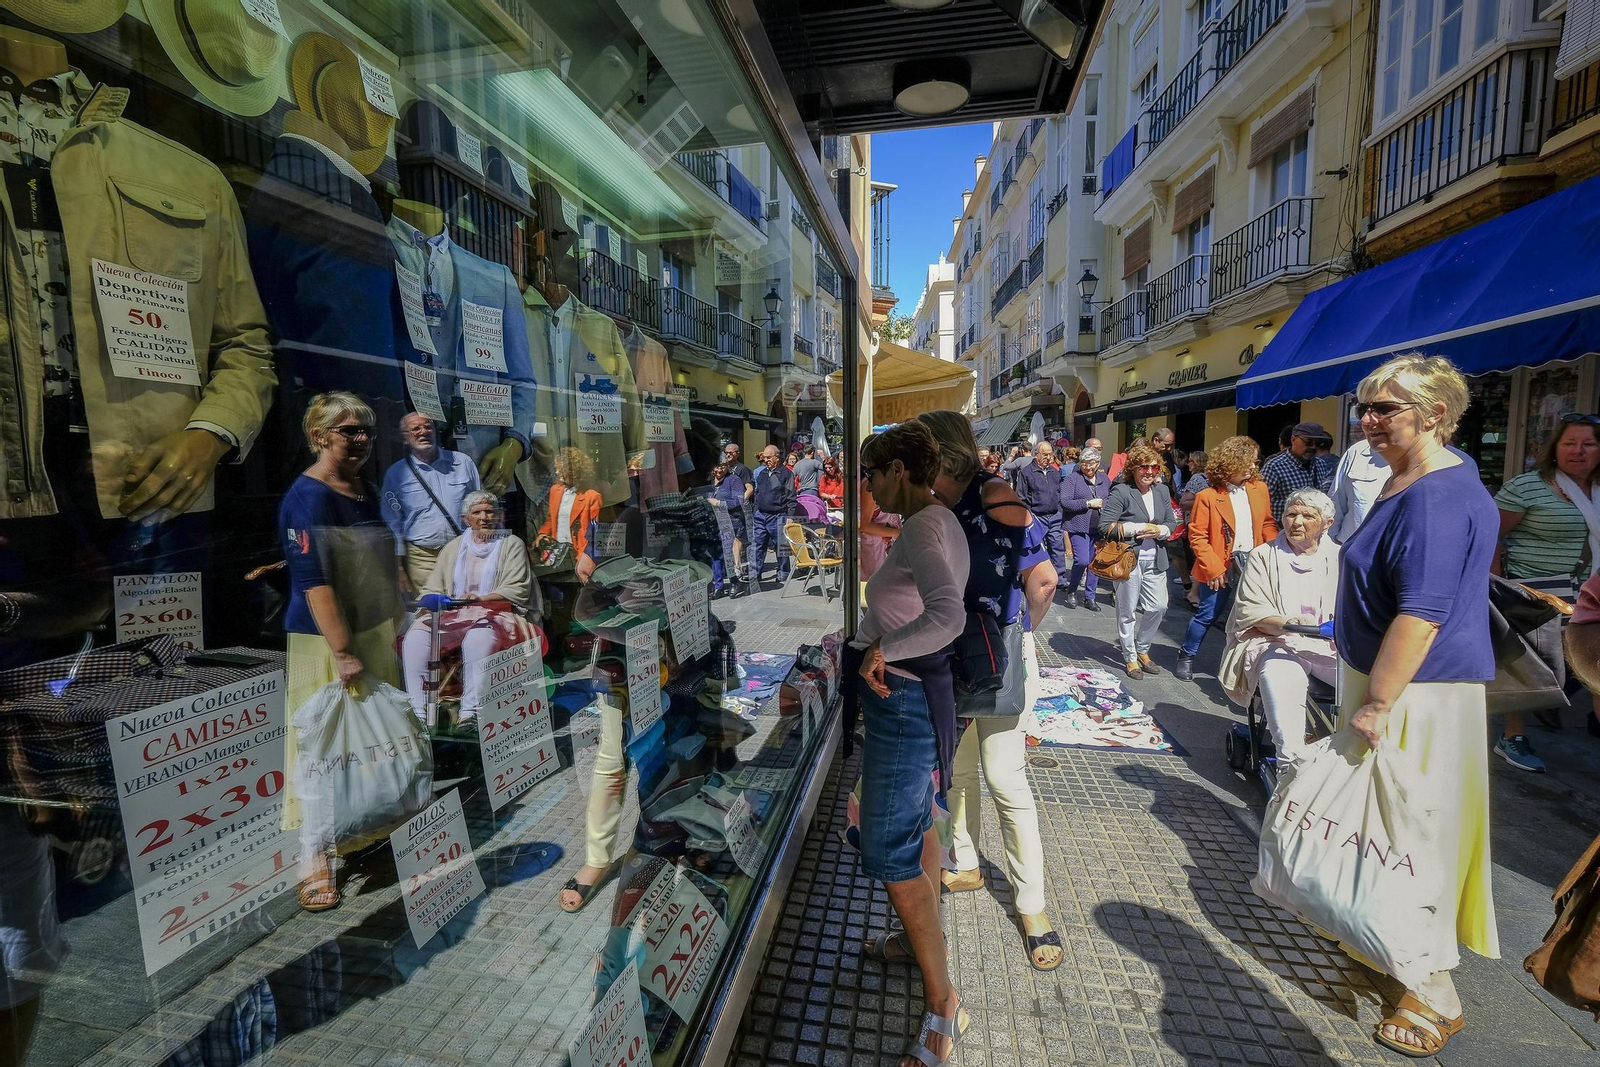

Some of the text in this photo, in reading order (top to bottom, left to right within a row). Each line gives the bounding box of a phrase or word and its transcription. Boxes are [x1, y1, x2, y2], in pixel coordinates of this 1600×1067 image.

[97, 262, 184, 291] Nueva Colección
[98, 277, 185, 304] Deportivas
[100, 290, 185, 313] Moda Primavera
[111, 326, 188, 346] Fresca-Ligera
[464, 320, 502, 335] Americanas
[110, 347, 195, 365] Tejido Natural
[117, 338, 186, 354] CALIDAD
[135, 367, 182, 380] Tinoco
[464, 383, 508, 395] DE REGALO
[117, 572, 199, 586] PANTALÓN
[120, 586, 197, 598] Algodón-Elastán
[158, 625, 196, 633] Fresco
[633, 634, 651, 649] POLOS
[478, 655, 500, 672] Nueva
[490, 659, 528, 686] POLOS
[478, 671, 542, 705] VERANO-Manga Corta
[120, 678, 277, 738] Nueva Colección
[640, 713, 658, 730] Tinoco
[143, 703, 267, 762] CAMISAS
[484, 715, 549, 754] Algodón Cotton
[487, 723, 548, 762] MUY FRESCO
[123, 725, 289, 794] VERANO-Manga Corta
[494, 746, 518, 764] Short
[504, 767, 548, 799] Tinoco
[396, 809, 462, 859] Manga Corta-Short sleeve
[408, 800, 446, 837] POLOS
[147, 838, 206, 874] Fácil
[164, 844, 224, 880] Short
[408, 880, 444, 911] Algodón
[417, 870, 472, 922] MUY FRESCO
[423, 881, 472, 927] SURTIDAZO
[180, 881, 287, 946] Tinoco
[433, 895, 470, 930] Tinoco
[682, 932, 716, 993] QUICK DRY
[691, 942, 721, 996] TINOCO
[574, 1014, 597, 1052] Nueva
[598, 965, 633, 1014] Colección
[589, 994, 626, 1056] POLOS
